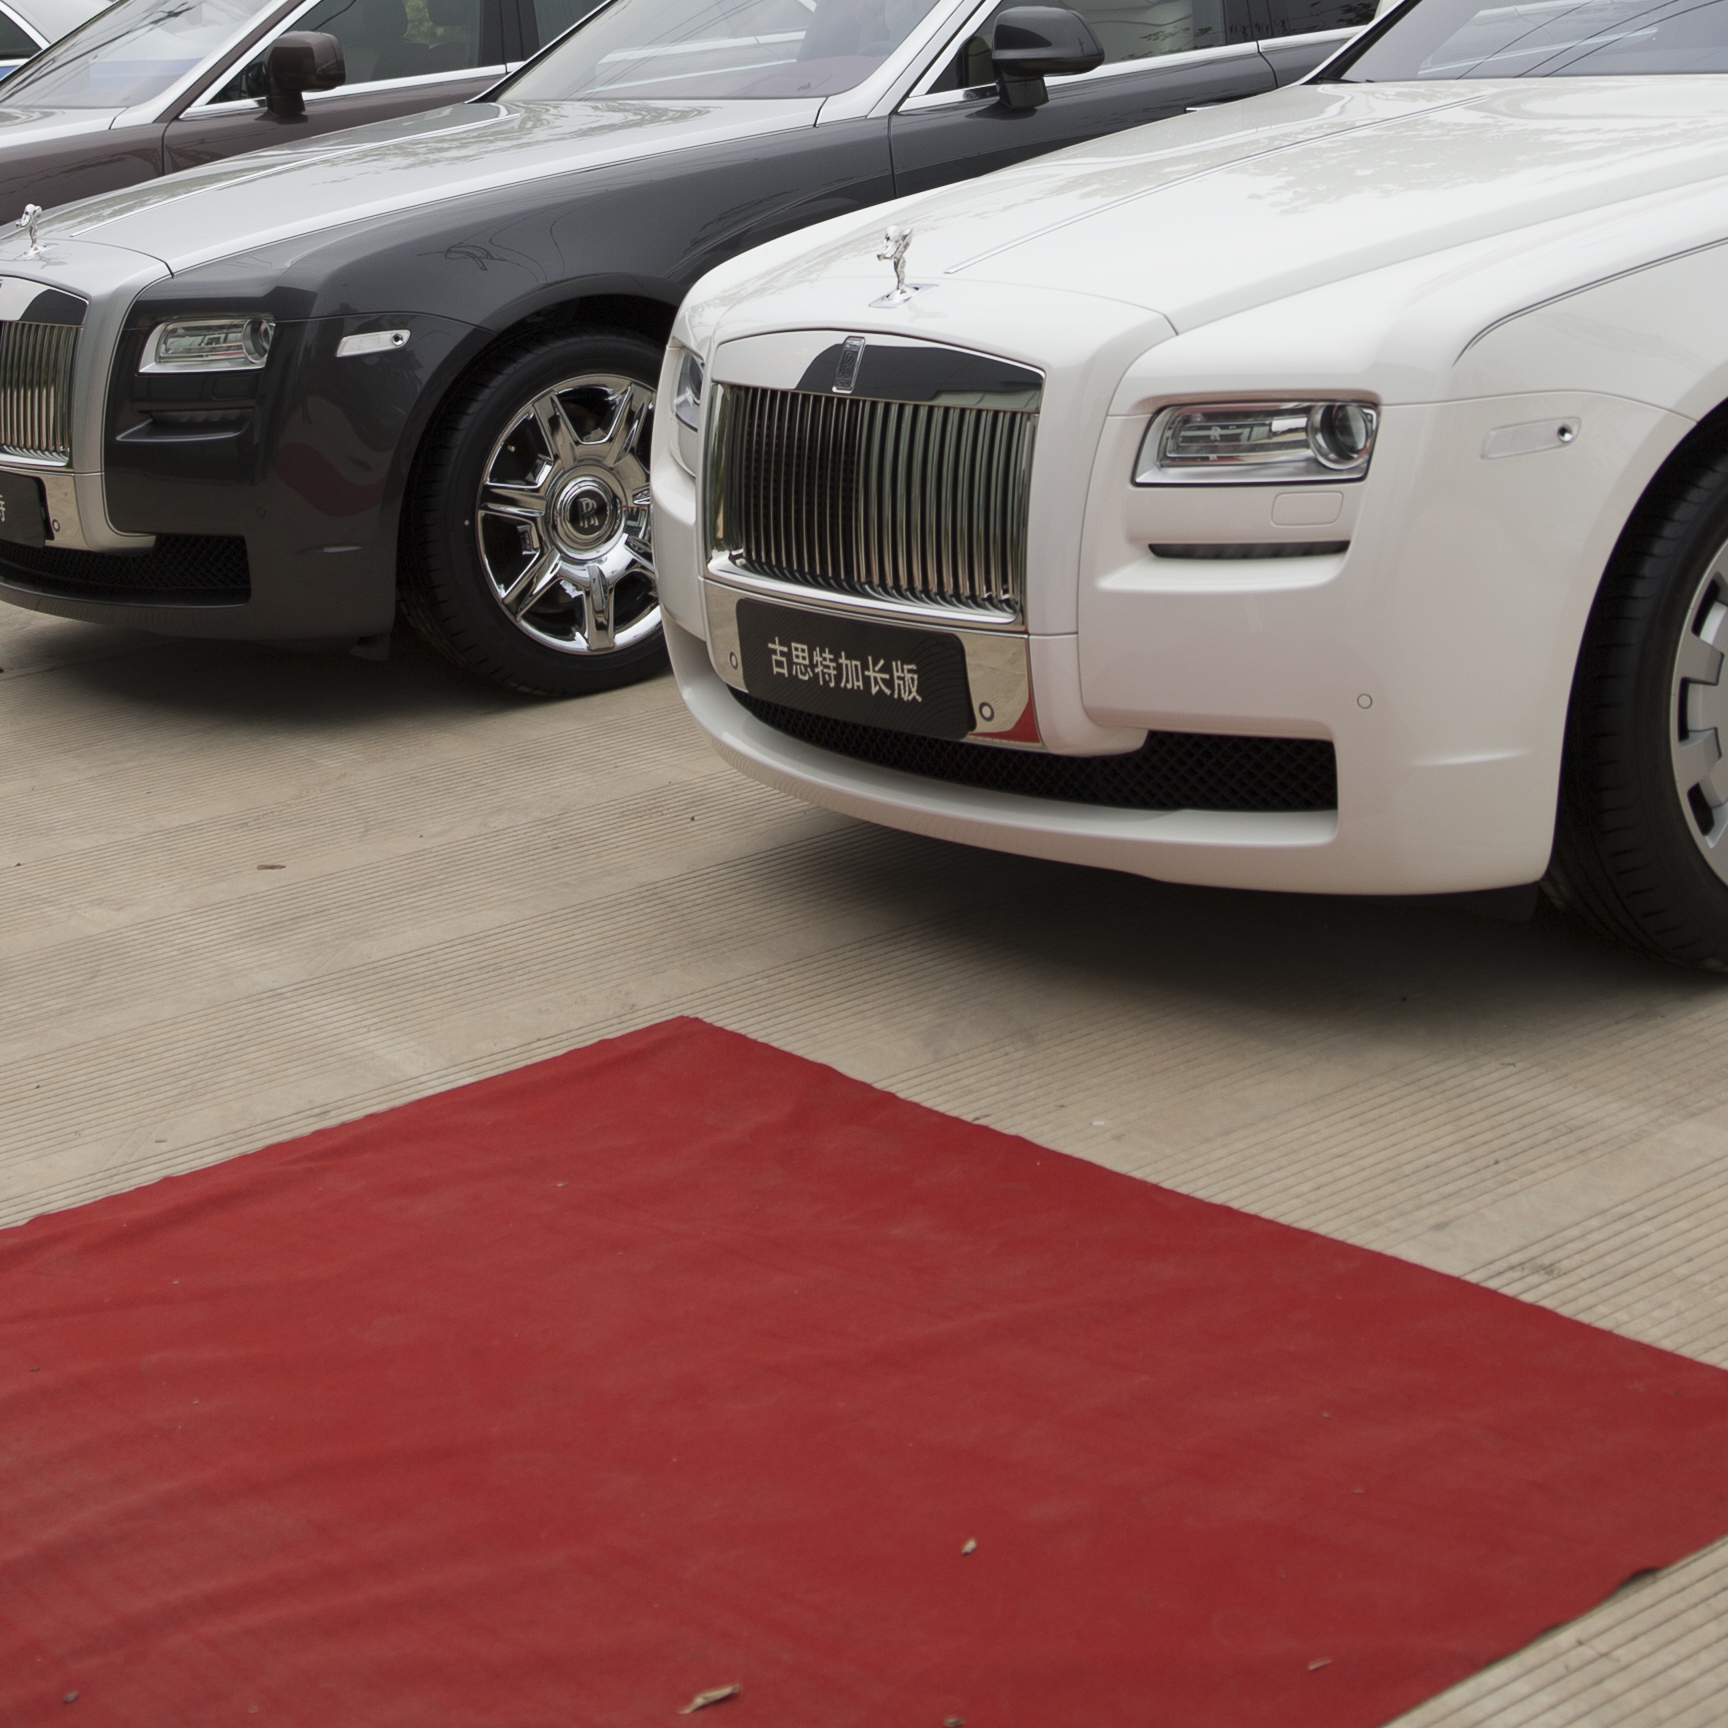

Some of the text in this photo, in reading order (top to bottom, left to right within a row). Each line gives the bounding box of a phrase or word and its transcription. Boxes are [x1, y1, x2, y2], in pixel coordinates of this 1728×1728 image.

[768, 636, 923, 703] 古思特加长版
